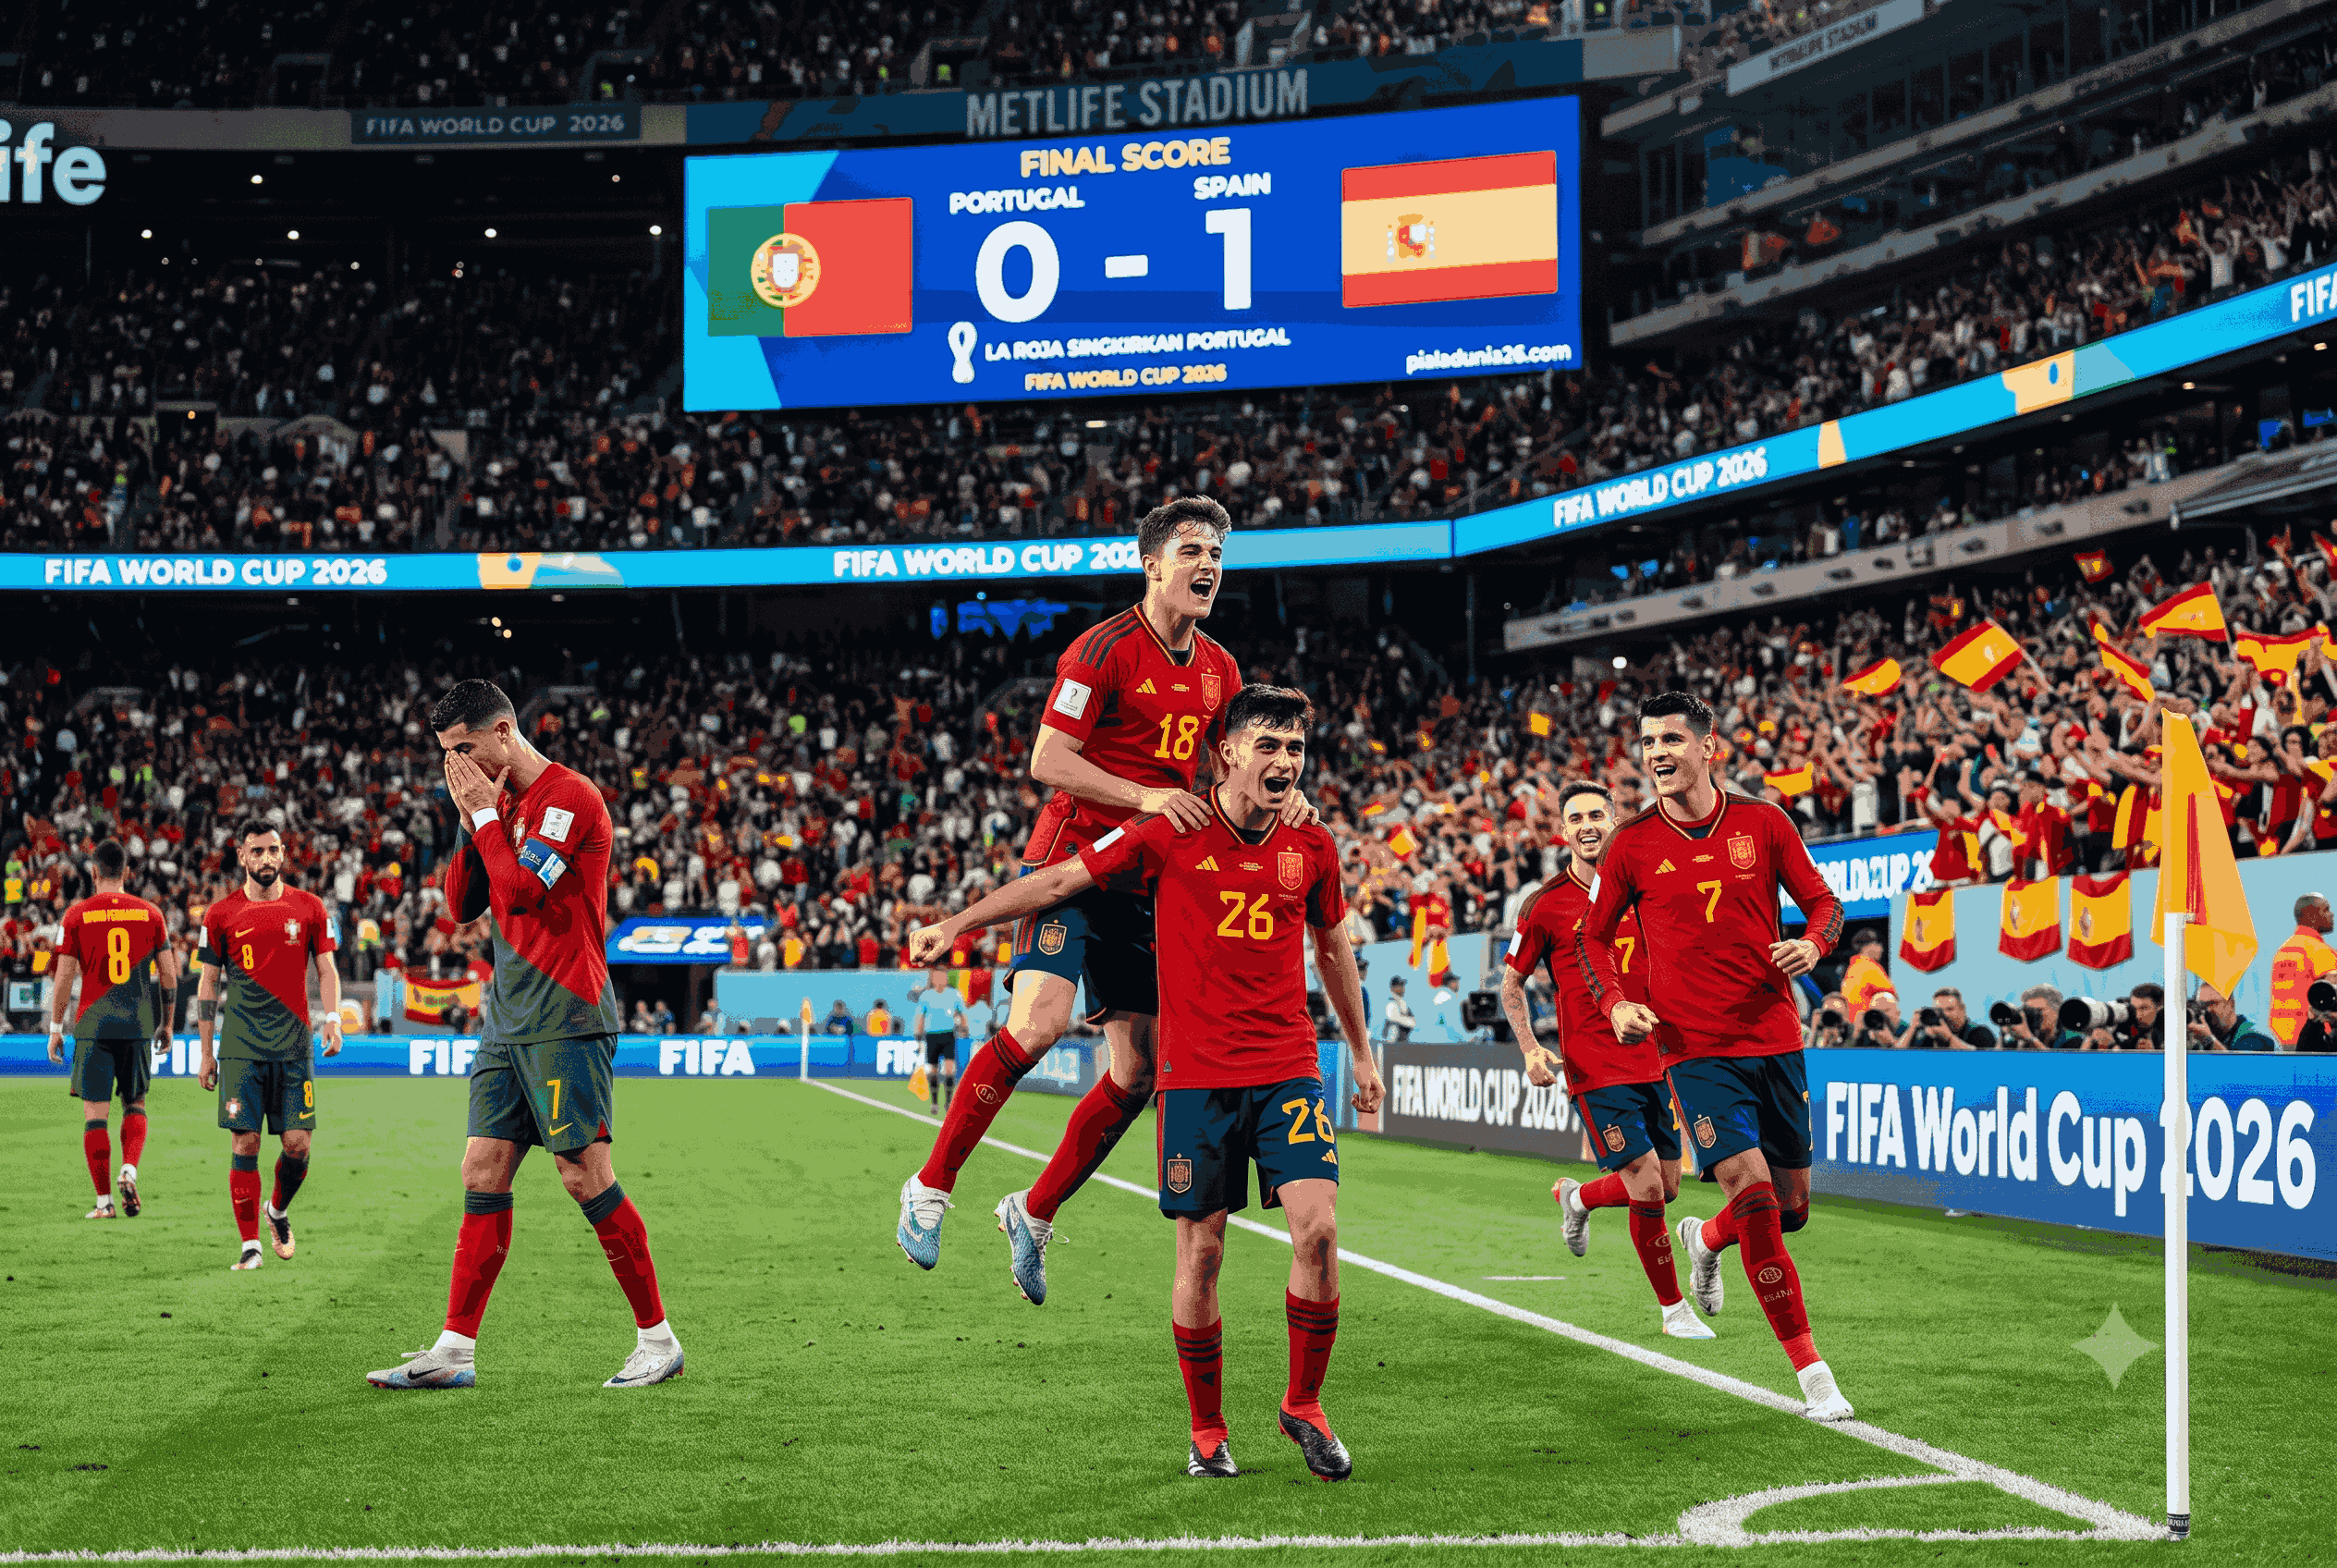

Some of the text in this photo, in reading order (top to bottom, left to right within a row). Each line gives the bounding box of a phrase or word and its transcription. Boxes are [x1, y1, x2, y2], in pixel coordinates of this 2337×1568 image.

[966, 68, 1308, 138] METLIFE STADIUM
[366, 114, 626, 135] FIFA WORLD CUP 2026
[1021, 137, 1230, 178] FINAL SCORE
[949, 186, 1085, 214] PORTUGAL
[1193, 172, 1271, 200] SPAIN
[975, 221, 1059, 323] 0
[1205, 208, 1252, 311] 1
[985, 342, 1011, 361] LA
[1013, 340, 1065, 361] ROJA
[1186, 327, 1291, 350] PORTUGAL
[1024, 373, 1067, 392] FIFA
[1068, 369, 1139, 389] WORLD
[1140, 366, 1181, 386] CUP
[1553, 446, 1768, 528] FIFA WORLD CUP 2026
[44, 557, 388, 586] FIFA WORLD CUP 2026
[834, 541, 1144, 578] FIFA WORLD CUP 202
[1154, 713, 1200, 761] 18
[1217, 890, 1274, 940] 26
[1696, 879, 1722, 924] 7
[107, 927, 130, 985] 8
[241, 944, 254, 970] 8
[409, 1039, 479, 1075] FIF
[659, 1040, 756, 1075] FIFA
[303, 1081, 313, 1108] 8
[546, 1079, 561, 1120] 7
[1392, 1064, 1425, 1118] FIFA
[1425, 1066, 1483, 1122] WORLD
[1483, 1068, 1521, 1127] CUP
[1281, 1097, 1335, 1145] 26
[1826, 1081, 1906, 1169] FIFA
[1911, 1085, 2037, 1182] World
[2047, 1090, 2147, 1218] Cup
